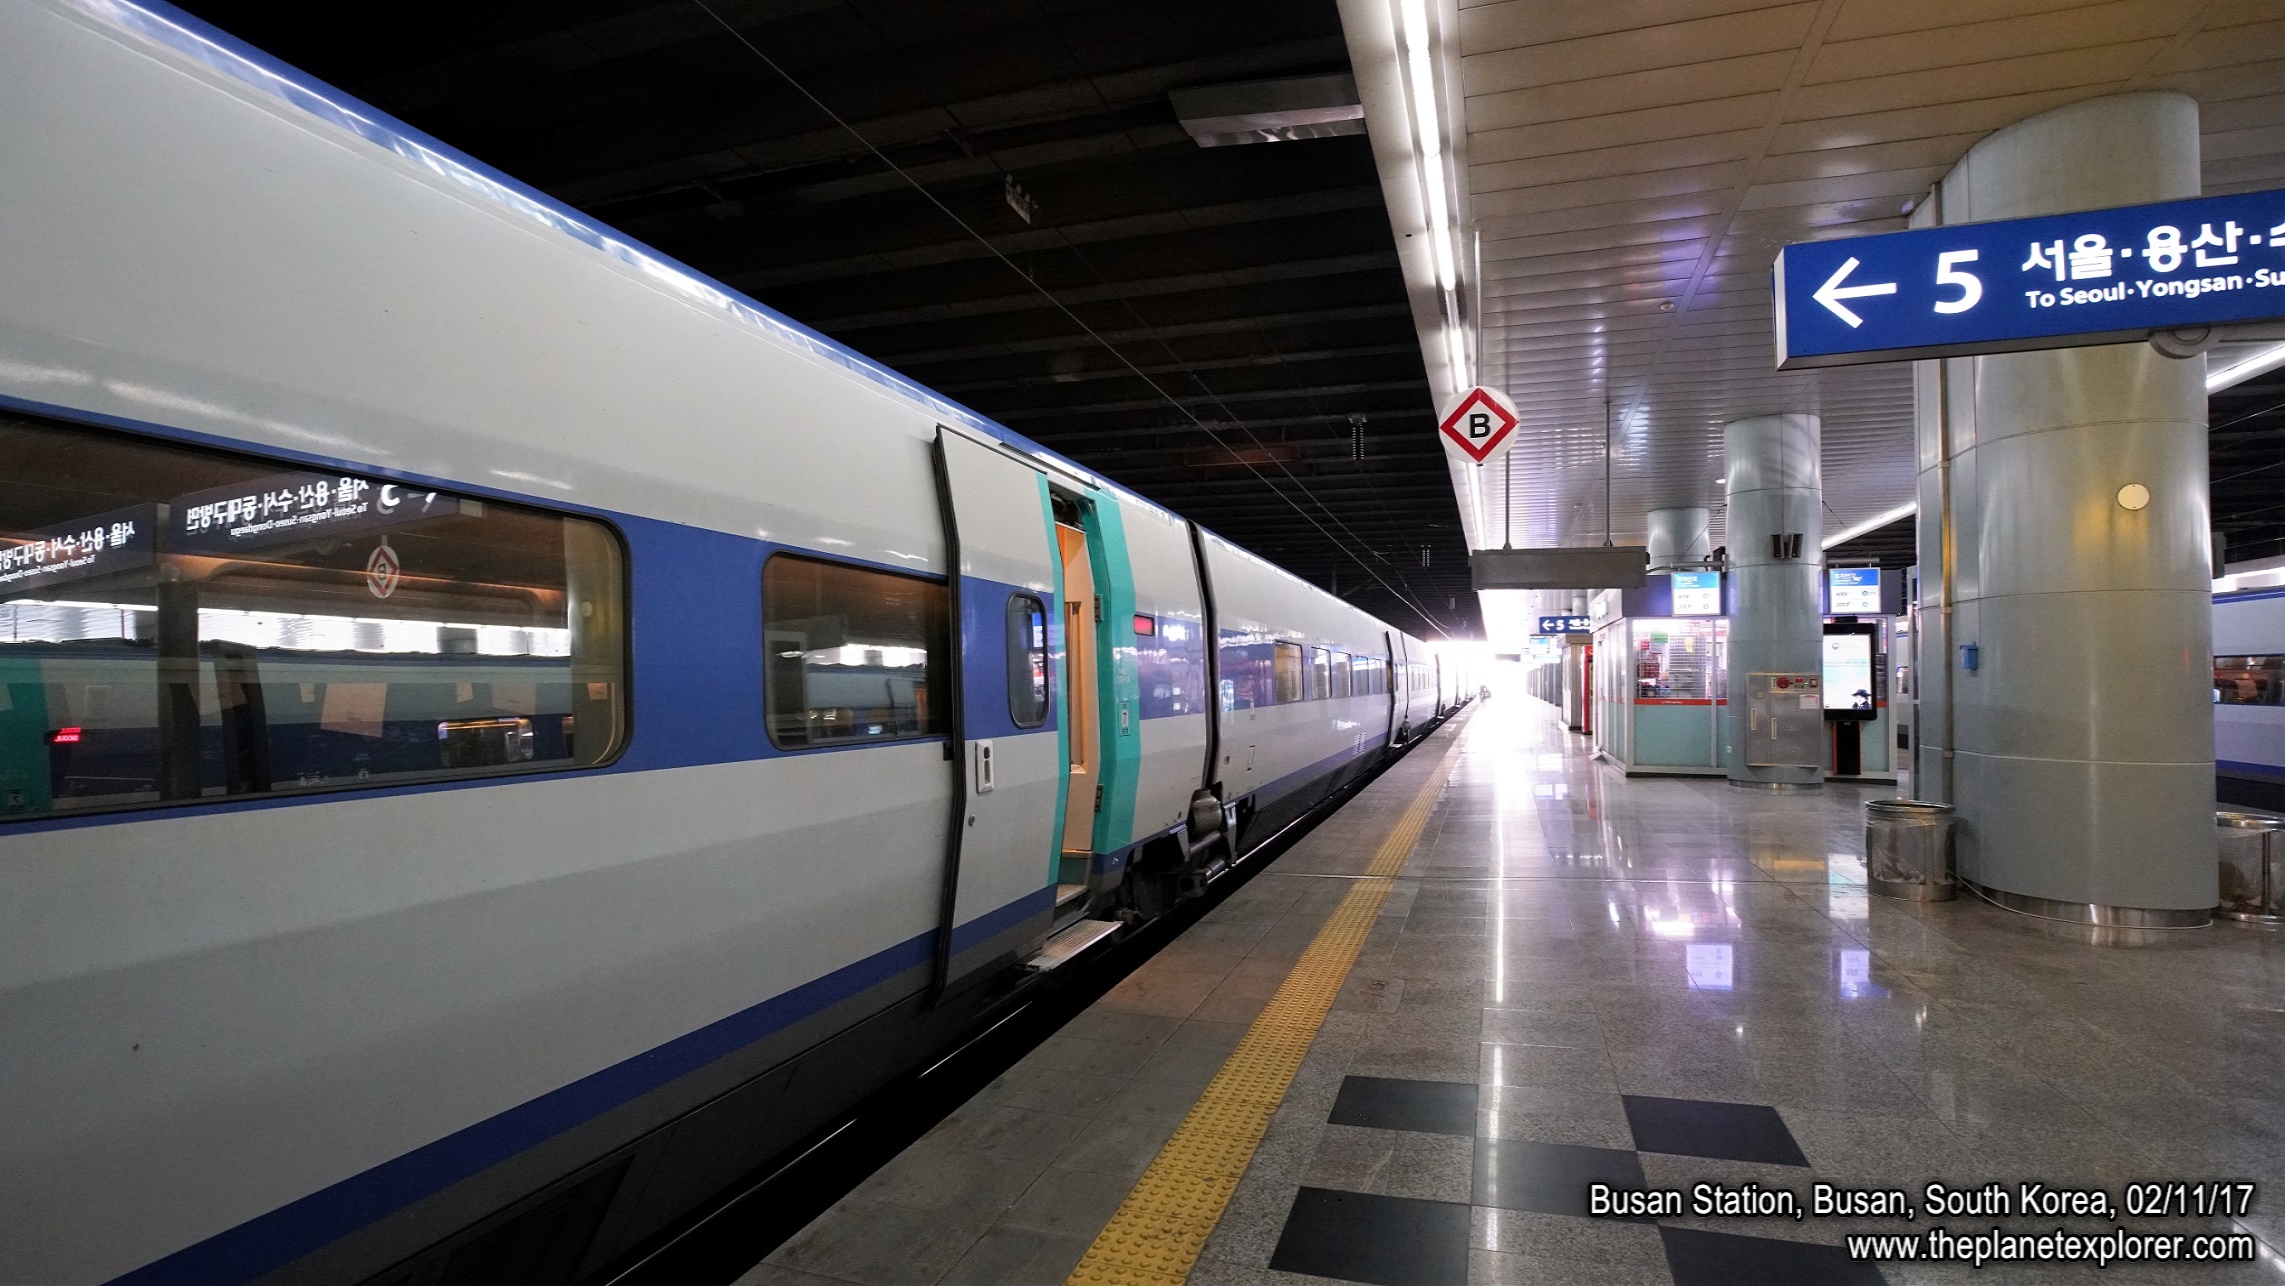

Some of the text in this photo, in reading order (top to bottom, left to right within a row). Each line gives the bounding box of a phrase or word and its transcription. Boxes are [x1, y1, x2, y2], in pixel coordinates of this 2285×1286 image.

[1933, 249, 1983, 314] 5
[2025, 290, 2056, 309] To
[1469, 413, 1491, 438] B
[1556, 619, 1565, 630] 5
